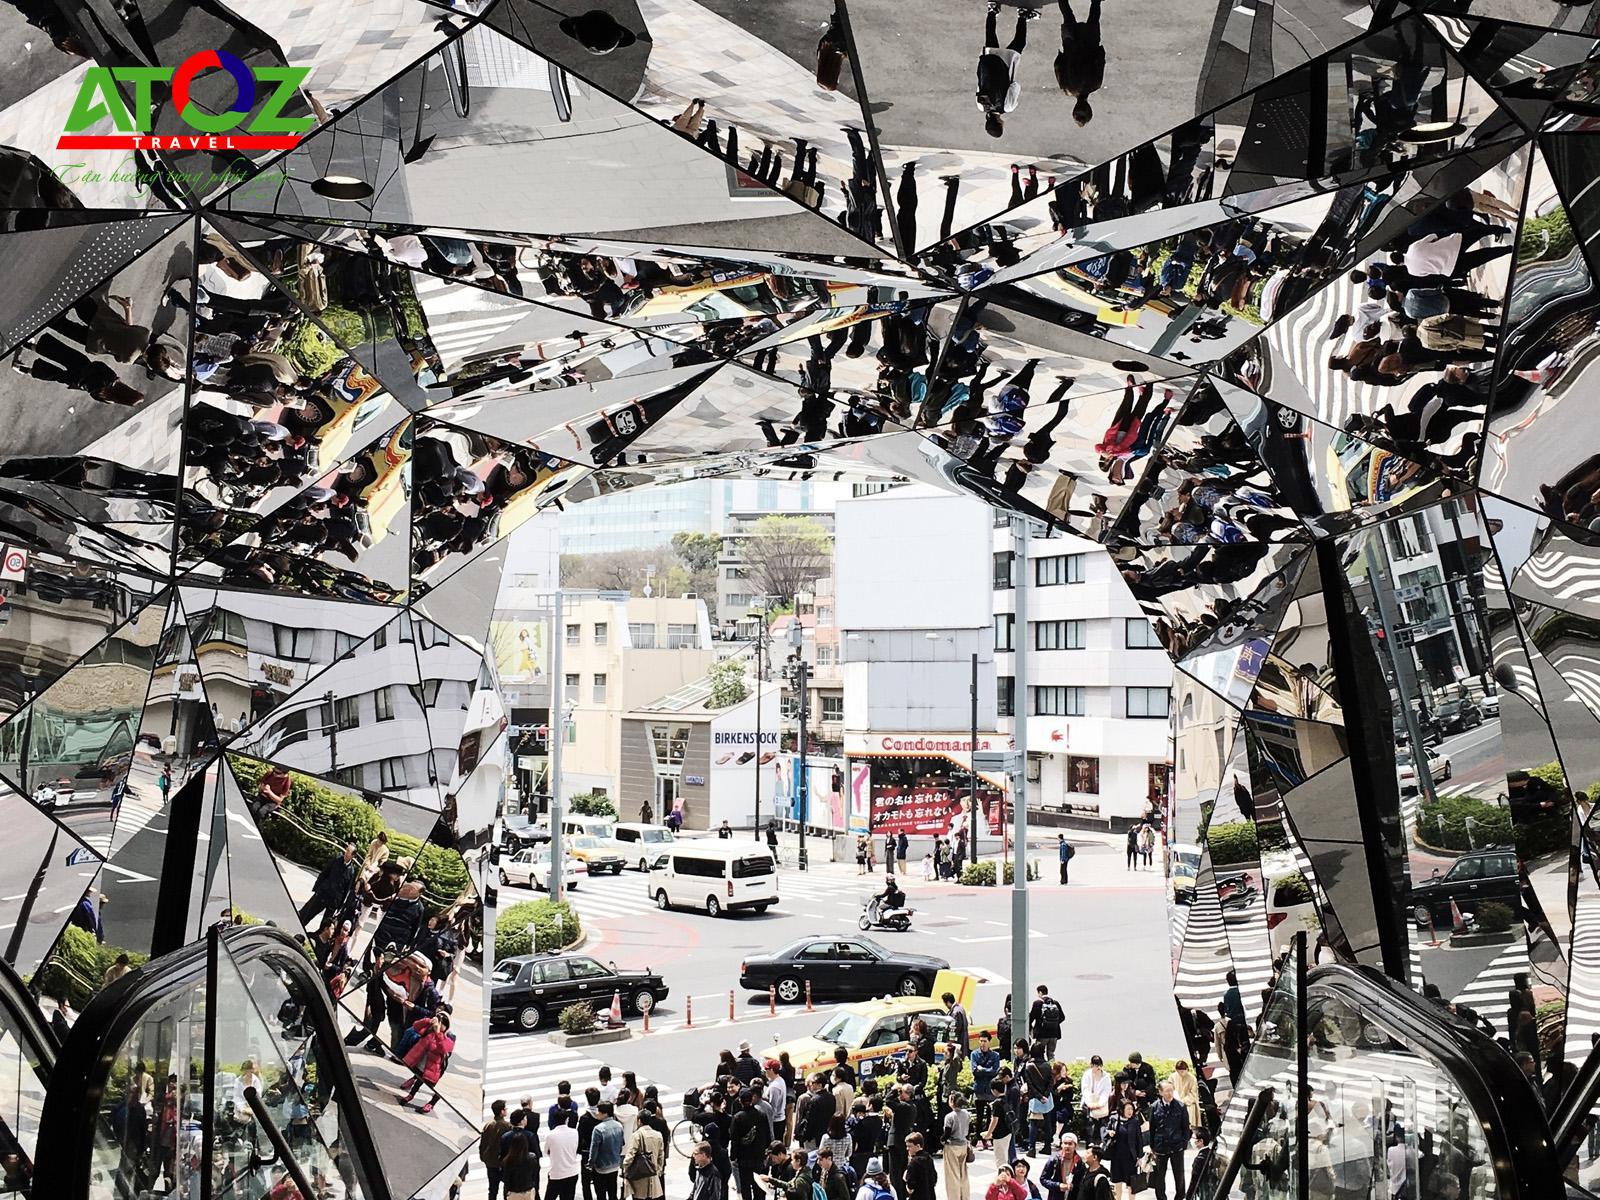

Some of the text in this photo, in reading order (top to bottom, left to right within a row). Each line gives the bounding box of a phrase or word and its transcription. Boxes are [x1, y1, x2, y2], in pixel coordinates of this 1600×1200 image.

[873, 808, 913, 822] オカモトも
